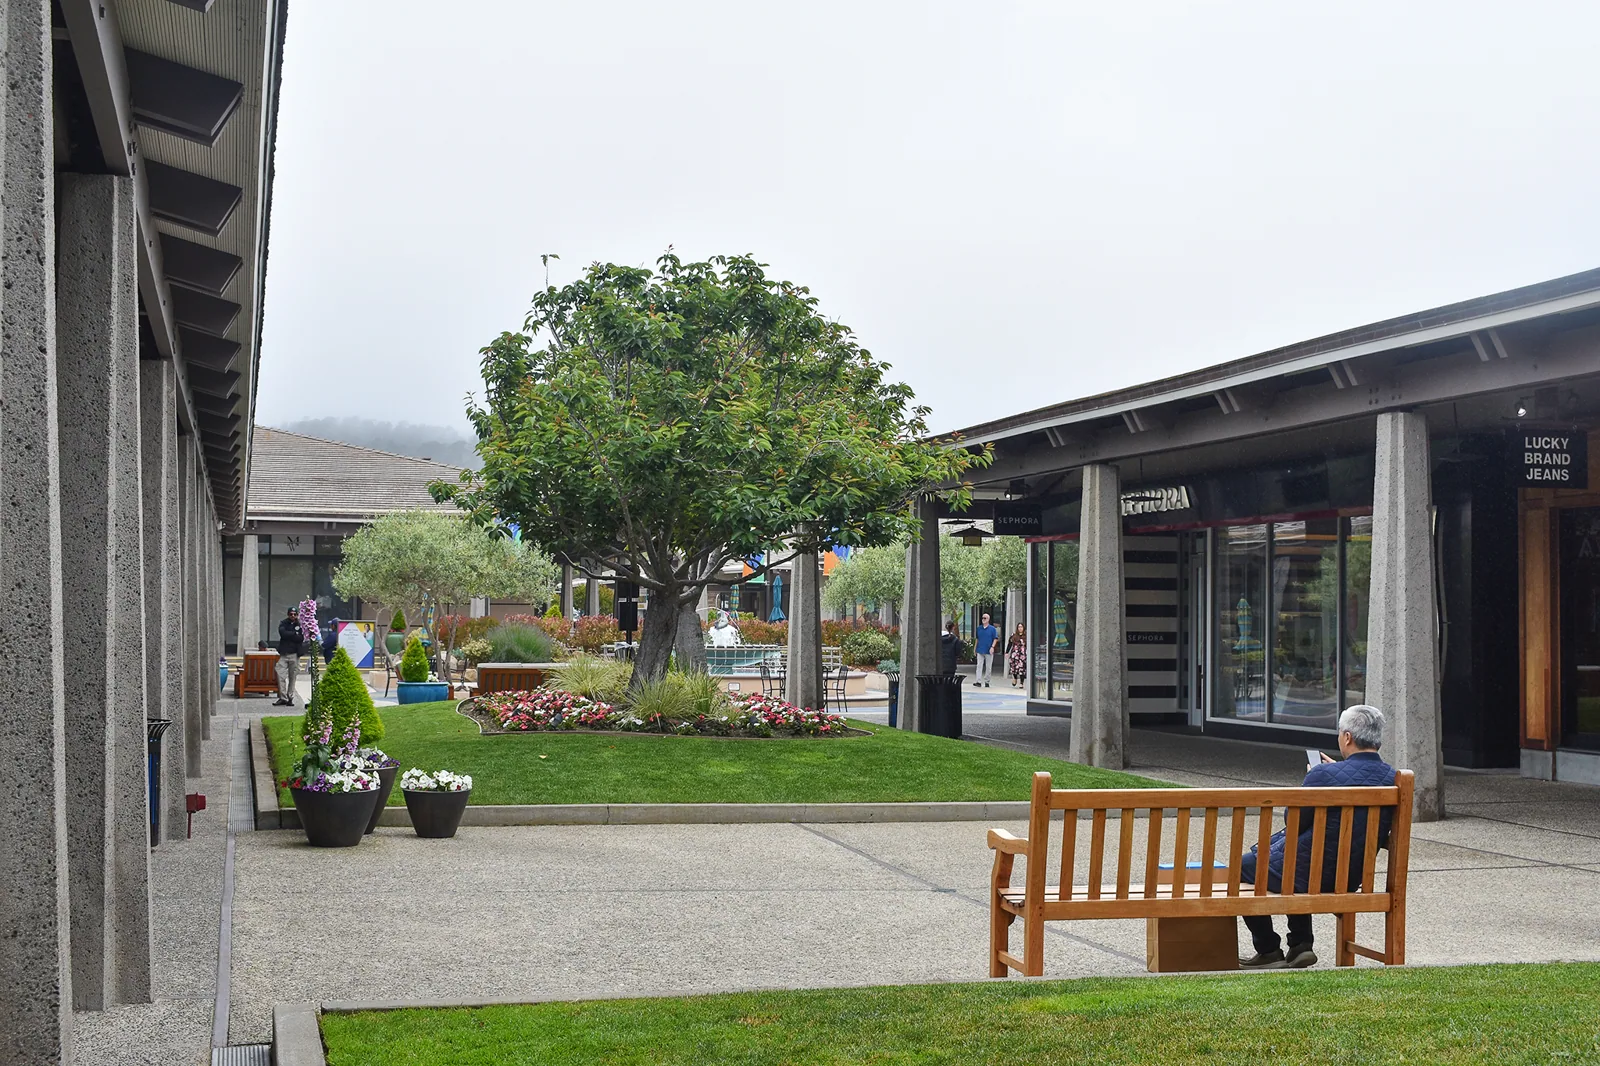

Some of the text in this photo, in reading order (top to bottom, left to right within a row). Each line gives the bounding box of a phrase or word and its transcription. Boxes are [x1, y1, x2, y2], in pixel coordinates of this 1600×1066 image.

[1525, 437, 1569, 449] LUCKY
[1524, 452, 1571, 466] BRAND
[1526, 468, 1570, 481] JEANS
[998, 516, 1039, 525] SEPHORA
[1127, 634, 1165, 642] SEPHORA
